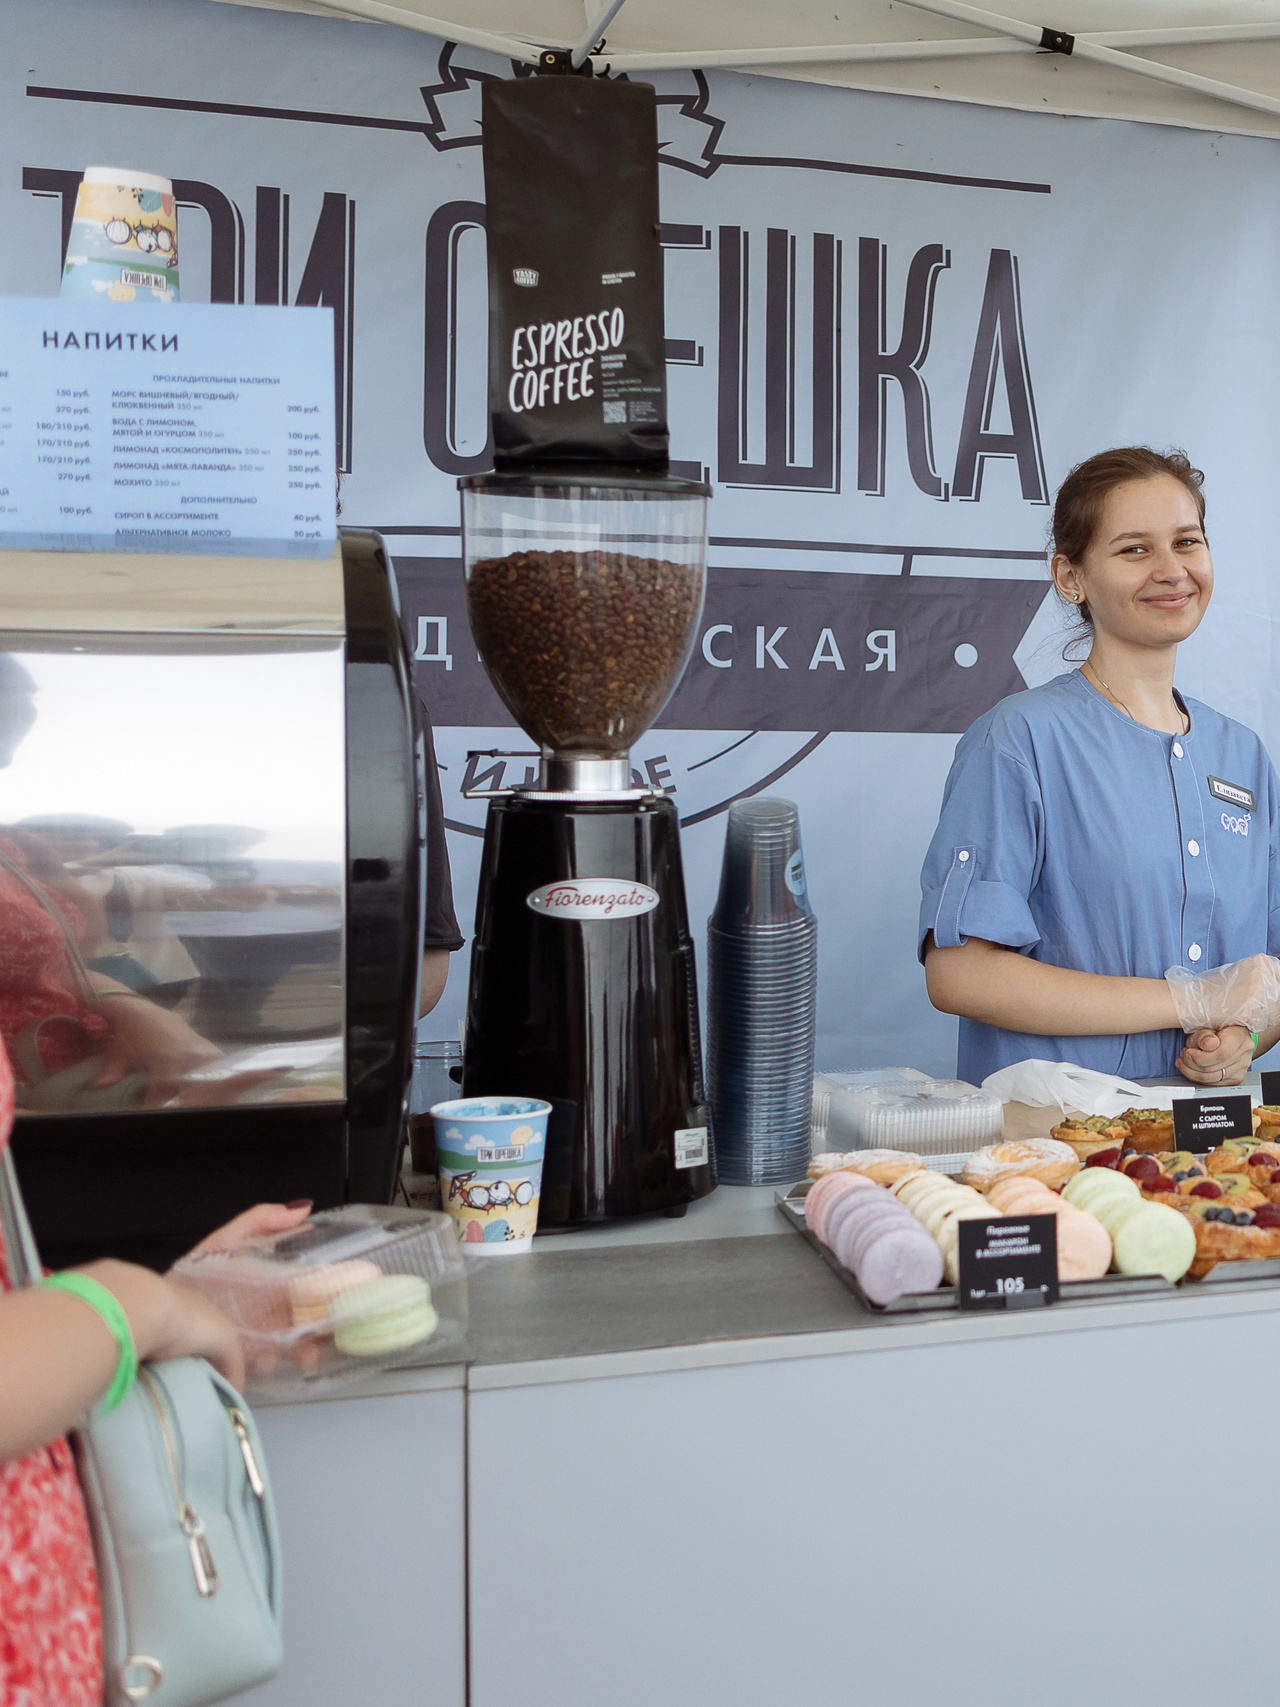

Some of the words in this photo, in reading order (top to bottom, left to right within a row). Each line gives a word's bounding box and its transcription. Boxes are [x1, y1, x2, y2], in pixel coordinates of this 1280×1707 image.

[42, 330, 179, 352] НАПИТКИ
[511, 307, 625, 371] ESPRESSO
[424, 200, 1050, 506] ОЕШКА
[153, 375, 238, 384] ПРОХЛАДИТЕЛЬНЫЕ
[240, 377, 280, 385] НАПИТКИ
[508, 357, 595, 413] COFFEE
[56, 389, 71, 397] 150
[73, 390, 91, 398] руб.
[112, 401, 174, 410] КЛЮКВЕННЫЙ
[304, 406, 321, 414] руб.
[74, 407, 91, 415] руб.
[36, 423, 72, 431] 180/210
[74, 424, 91, 432] руб.
[112, 418, 136, 426] ВОДА
[146, 419, 197, 428] ЛИМОНОМ,
[113, 429, 143, 437] МЯТОЙ
[154, 430, 196, 438] ОГУРЦОМ
[304, 433, 321, 441] руб.
[37, 439, 73, 447] 170/210
[74, 440, 92, 448] руб.
[113, 446, 159, 454] ЛИМОНАД
[161, 446, 242, 455] «КОСМОПОЛИТЕН»
[304, 450, 321, 458] руб.
[37, 456, 73, 464] 170/210
[75, 457, 92, 465] руб.
[113, 462, 159, 470] ЛИМОНАД
[161, 463, 236, 471] «МЯТА-ЛАВАНДА»
[305, 466, 322, 474] руб.
[75, 474, 93, 482] руб.
[305, 482, 322, 490] руб.
[180, 496, 257, 504] ДОПОЛНИТЕЛЬНО
[76, 507, 94, 515] руб.
[114, 512, 145, 520] СИРОП
[306, 515, 323, 523] руб.
[115, 529, 189, 537] АЛЬТЕРНАТИВНОЕ
[306, 531, 323, 539] руб.
[545, 886, 645, 914] Fiorenzato
[1199, 1105, 1225, 1113] Бриошь
[1204, 1114, 1227, 1122] СЫРОМ
[1199, 1120, 1235, 1129] ШПИНАТОМ
[480, 1149, 493, 1160] ТРИ
[495, 1147, 522, 1160] ОРЕШКА
[995, 1276, 1025, 1294] 105
